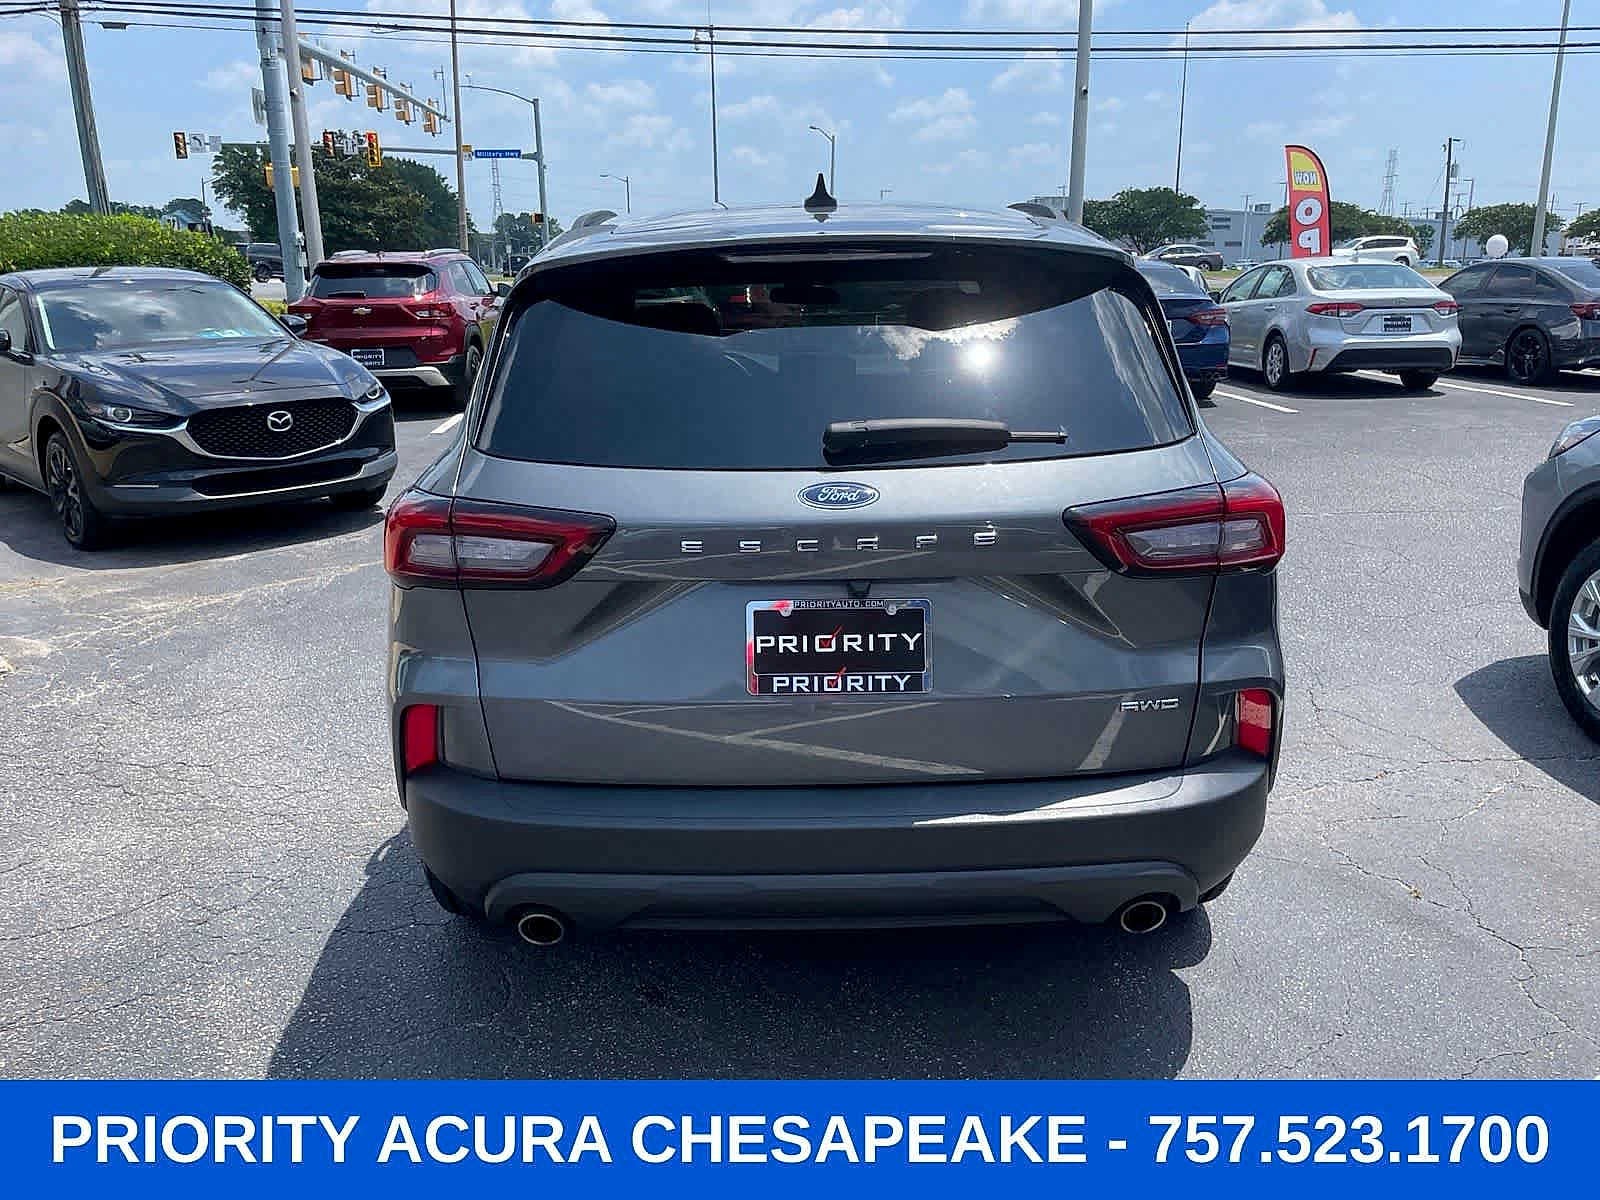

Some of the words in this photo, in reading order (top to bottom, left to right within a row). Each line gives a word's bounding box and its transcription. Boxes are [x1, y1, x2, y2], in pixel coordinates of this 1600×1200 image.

[817, 486, 861, 501] Ford
[681, 527, 997, 553] ESCAPE
[793, 599, 884, 608] PRIORITYAUTO.COM
[755, 632, 923, 654] PRIORITY
[772, 674, 912, 693] PRIORITY
[1120, 698, 1179, 711] AWD
